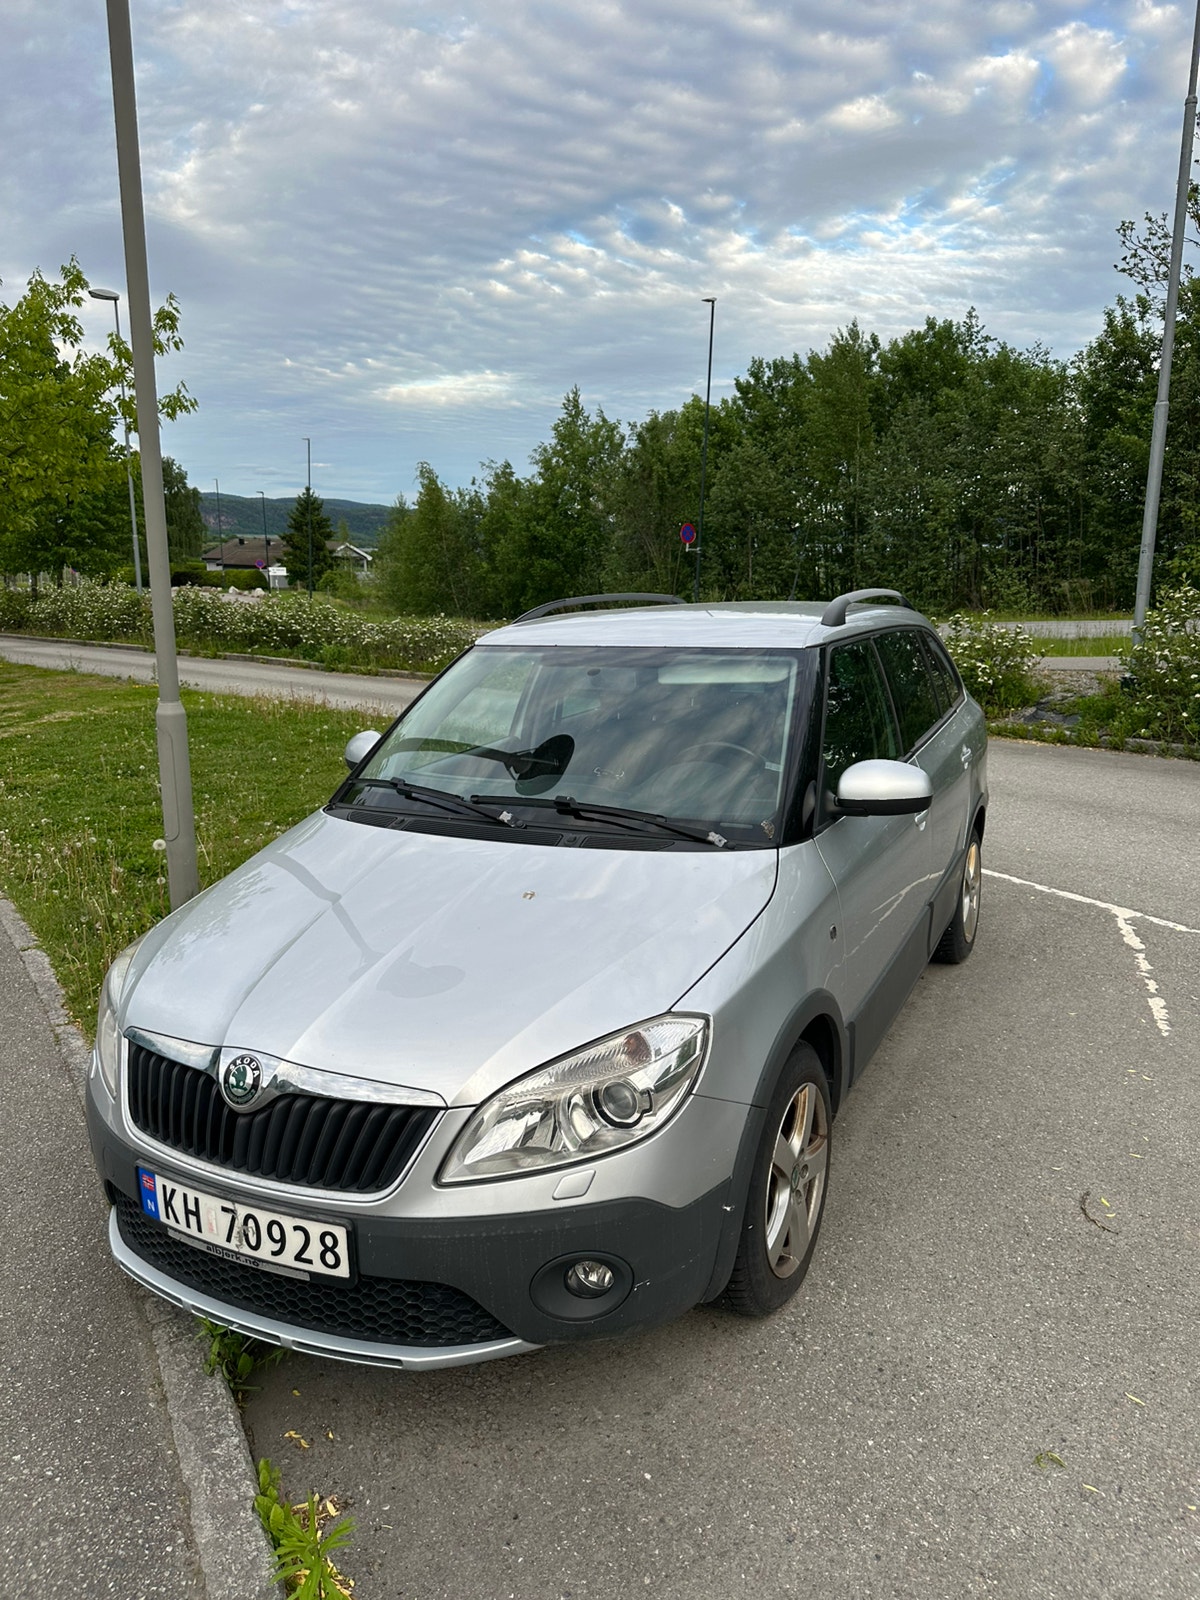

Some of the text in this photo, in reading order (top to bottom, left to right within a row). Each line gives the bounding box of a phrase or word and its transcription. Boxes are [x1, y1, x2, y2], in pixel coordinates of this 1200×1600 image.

[147, 1199, 156, 1212] N
[162, 1184, 341, 1269] KH 70928
